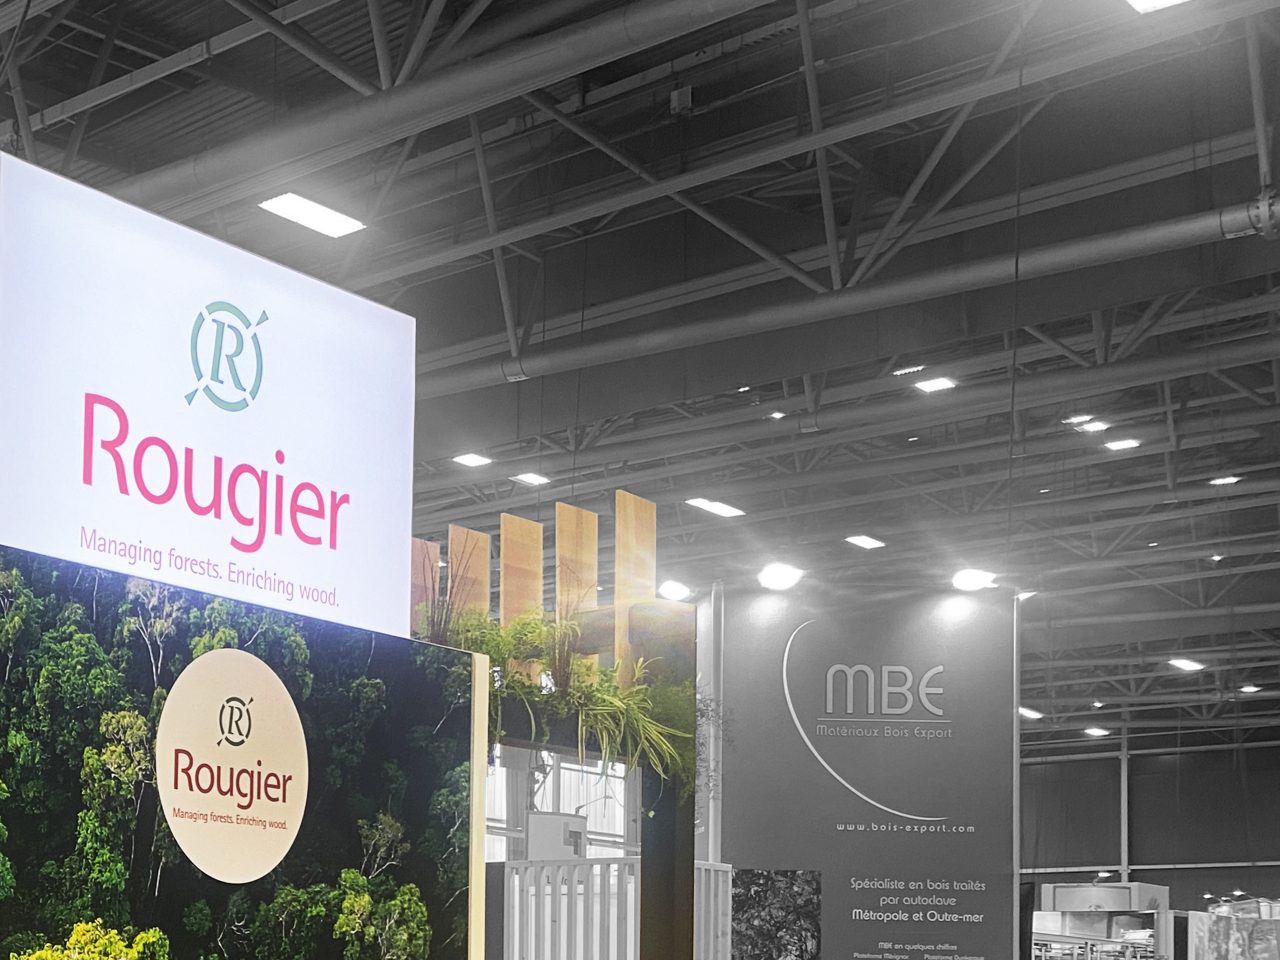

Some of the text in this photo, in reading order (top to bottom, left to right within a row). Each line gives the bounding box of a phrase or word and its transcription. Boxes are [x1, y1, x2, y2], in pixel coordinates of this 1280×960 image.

[82, 392, 351, 554] Rougier
[79, 526, 340, 608] Managing forests. Enriching wood.
[825, 663, 945, 717] MBE
[816, 724, 953, 740] Matériaux Bois Export
[173, 748, 293, 810] Rougier
[172, 807, 288, 830] Managing forests. Enriching wood.
[836, 822, 976, 834] www.bois-export.com
[850, 877, 986, 891] Spécialiste en bois traités
[880, 895, 900, 907] par
[852, 908, 984, 923] Métropole et Outre-mer
